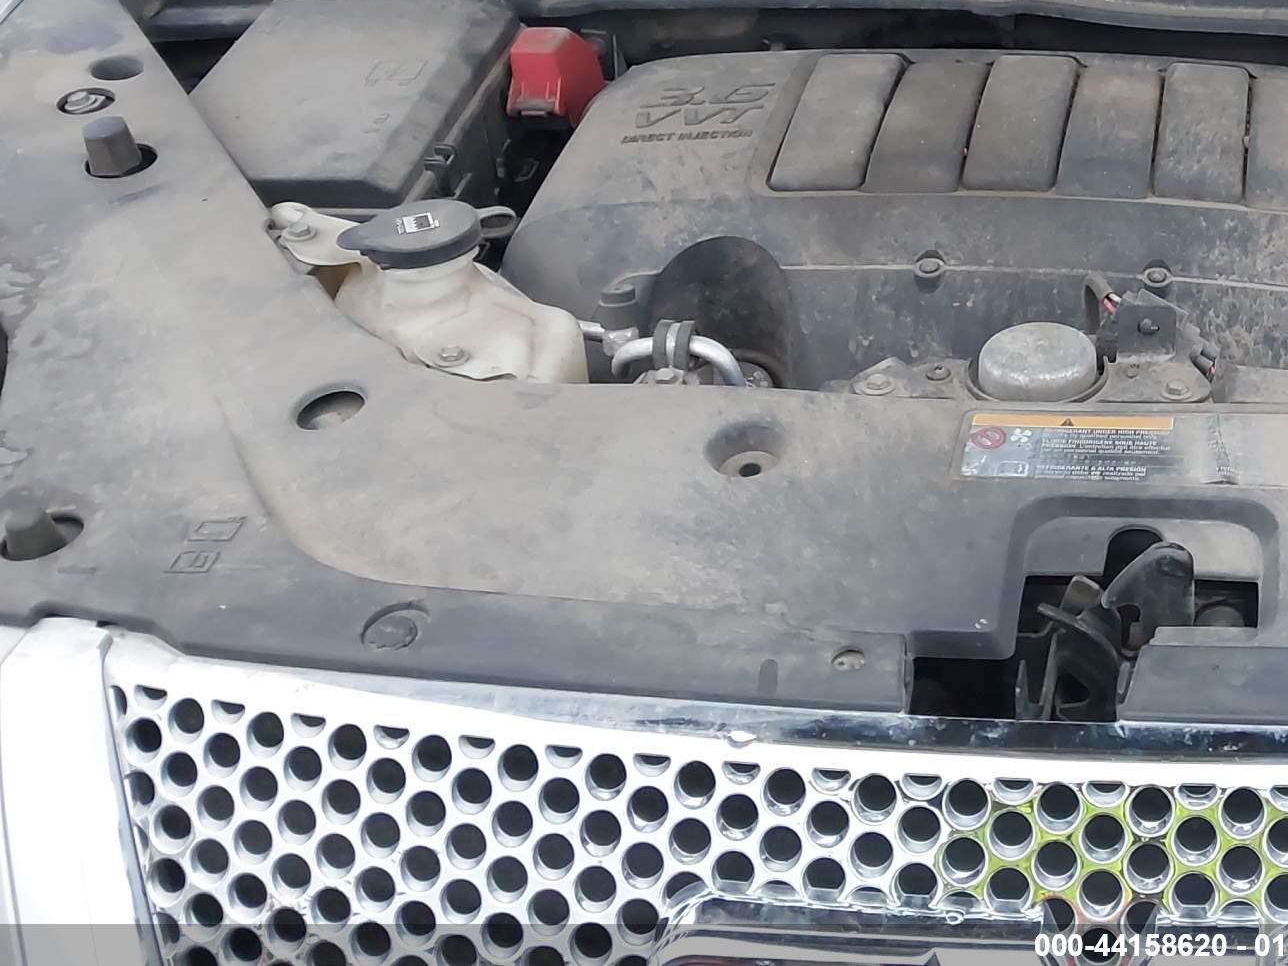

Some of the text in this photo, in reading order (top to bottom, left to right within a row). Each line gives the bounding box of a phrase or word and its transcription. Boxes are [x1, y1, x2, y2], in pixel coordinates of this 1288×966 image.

[639, 82, 777, 109] 3.6
[635, 104, 765, 129] VVT
[620, 129, 754, 144] DIRECT INJECTION
